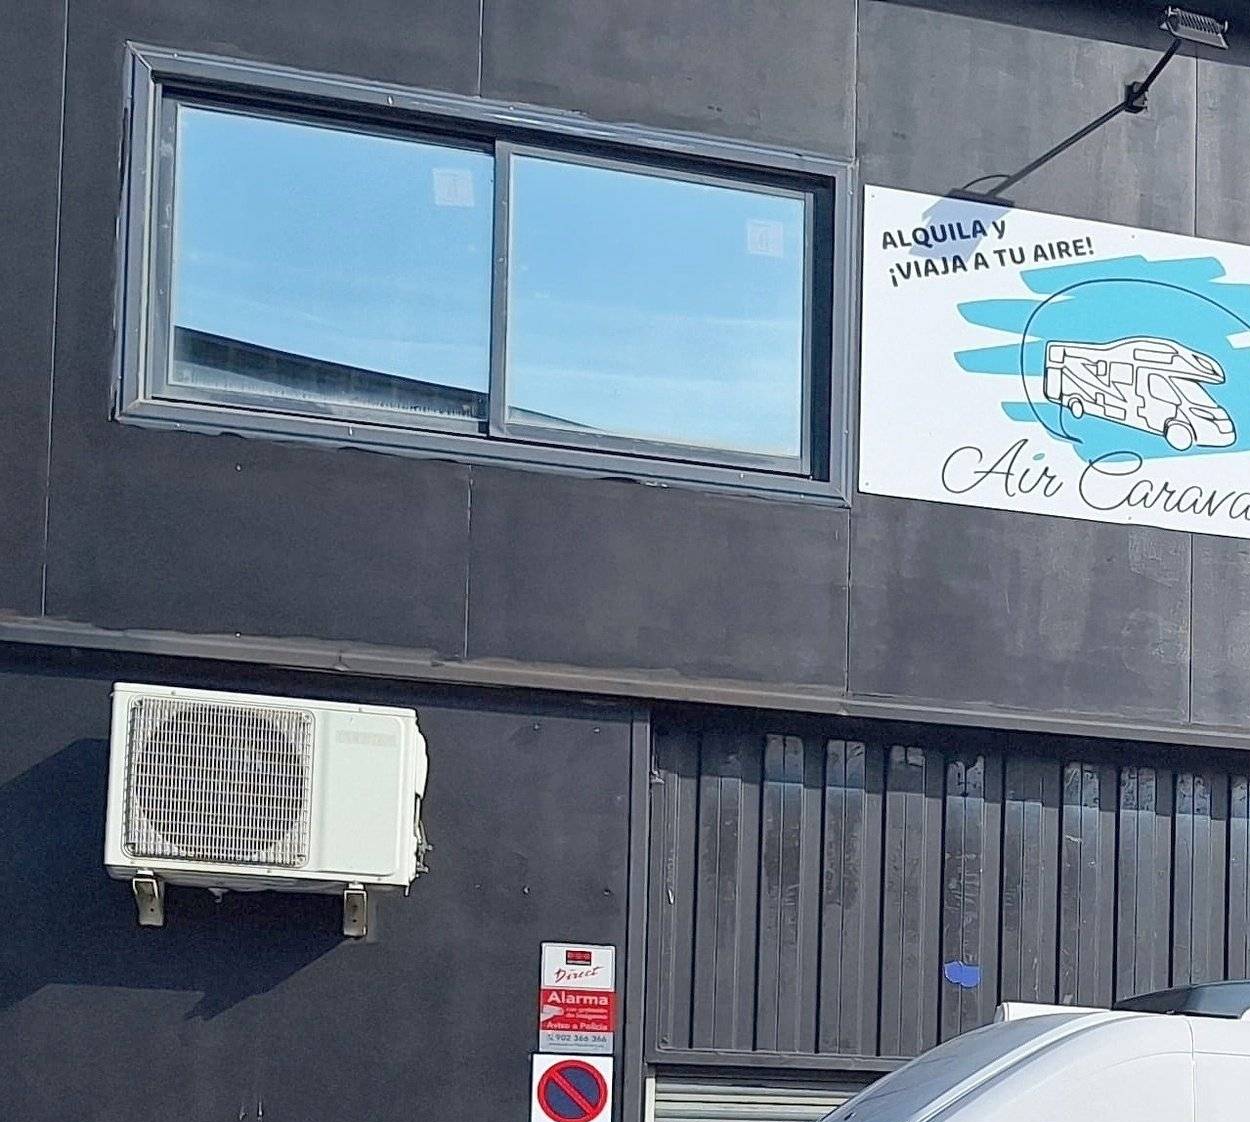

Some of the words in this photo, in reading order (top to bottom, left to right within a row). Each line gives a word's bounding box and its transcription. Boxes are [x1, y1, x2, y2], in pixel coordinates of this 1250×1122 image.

[882, 219, 988, 250] ALQUILA
[991, 219, 1006, 240] y
[889, 253, 968, 288] ¡VIAJA
[974, 252, 990, 271] A
[993, 246, 1026, 267] TU
[1033, 236, 1095, 263] AIRE!
[941, 438, 1063, 498] Air
[547, 990, 609, 1006] Alarma
